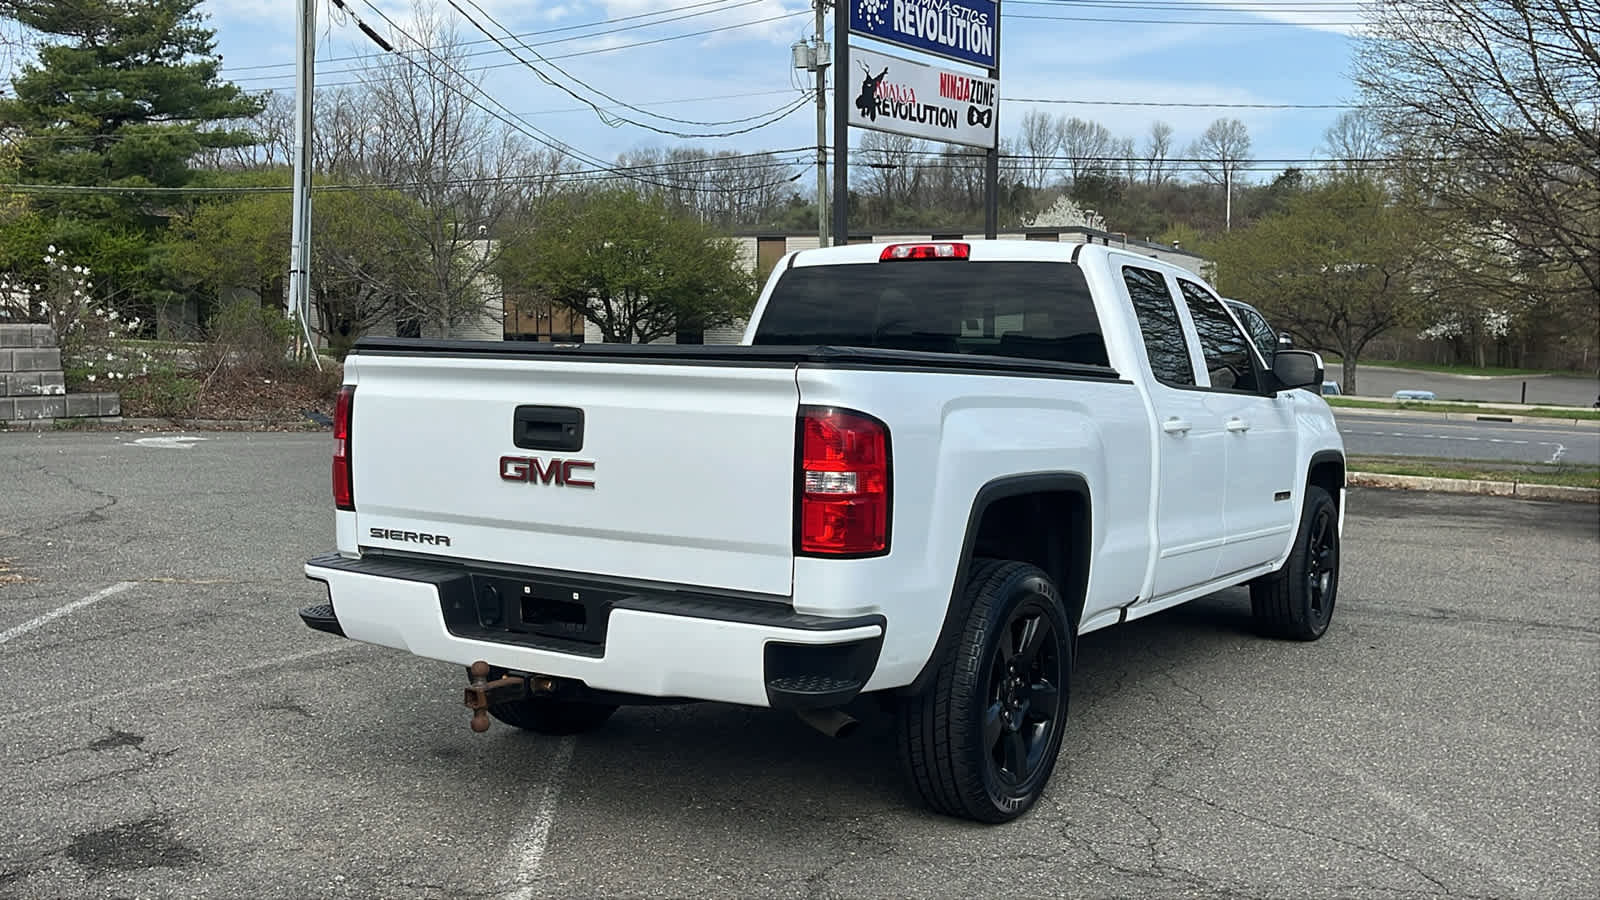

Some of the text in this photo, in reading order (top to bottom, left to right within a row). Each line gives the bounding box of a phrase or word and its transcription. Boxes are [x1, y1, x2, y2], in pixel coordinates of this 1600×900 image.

[894, 0, 992, 56] REVOLUTION
[874, 95, 958, 129] REVOLUTION
[500, 455, 596, 490] GMC
[369, 527, 451, 547] SIERRA
